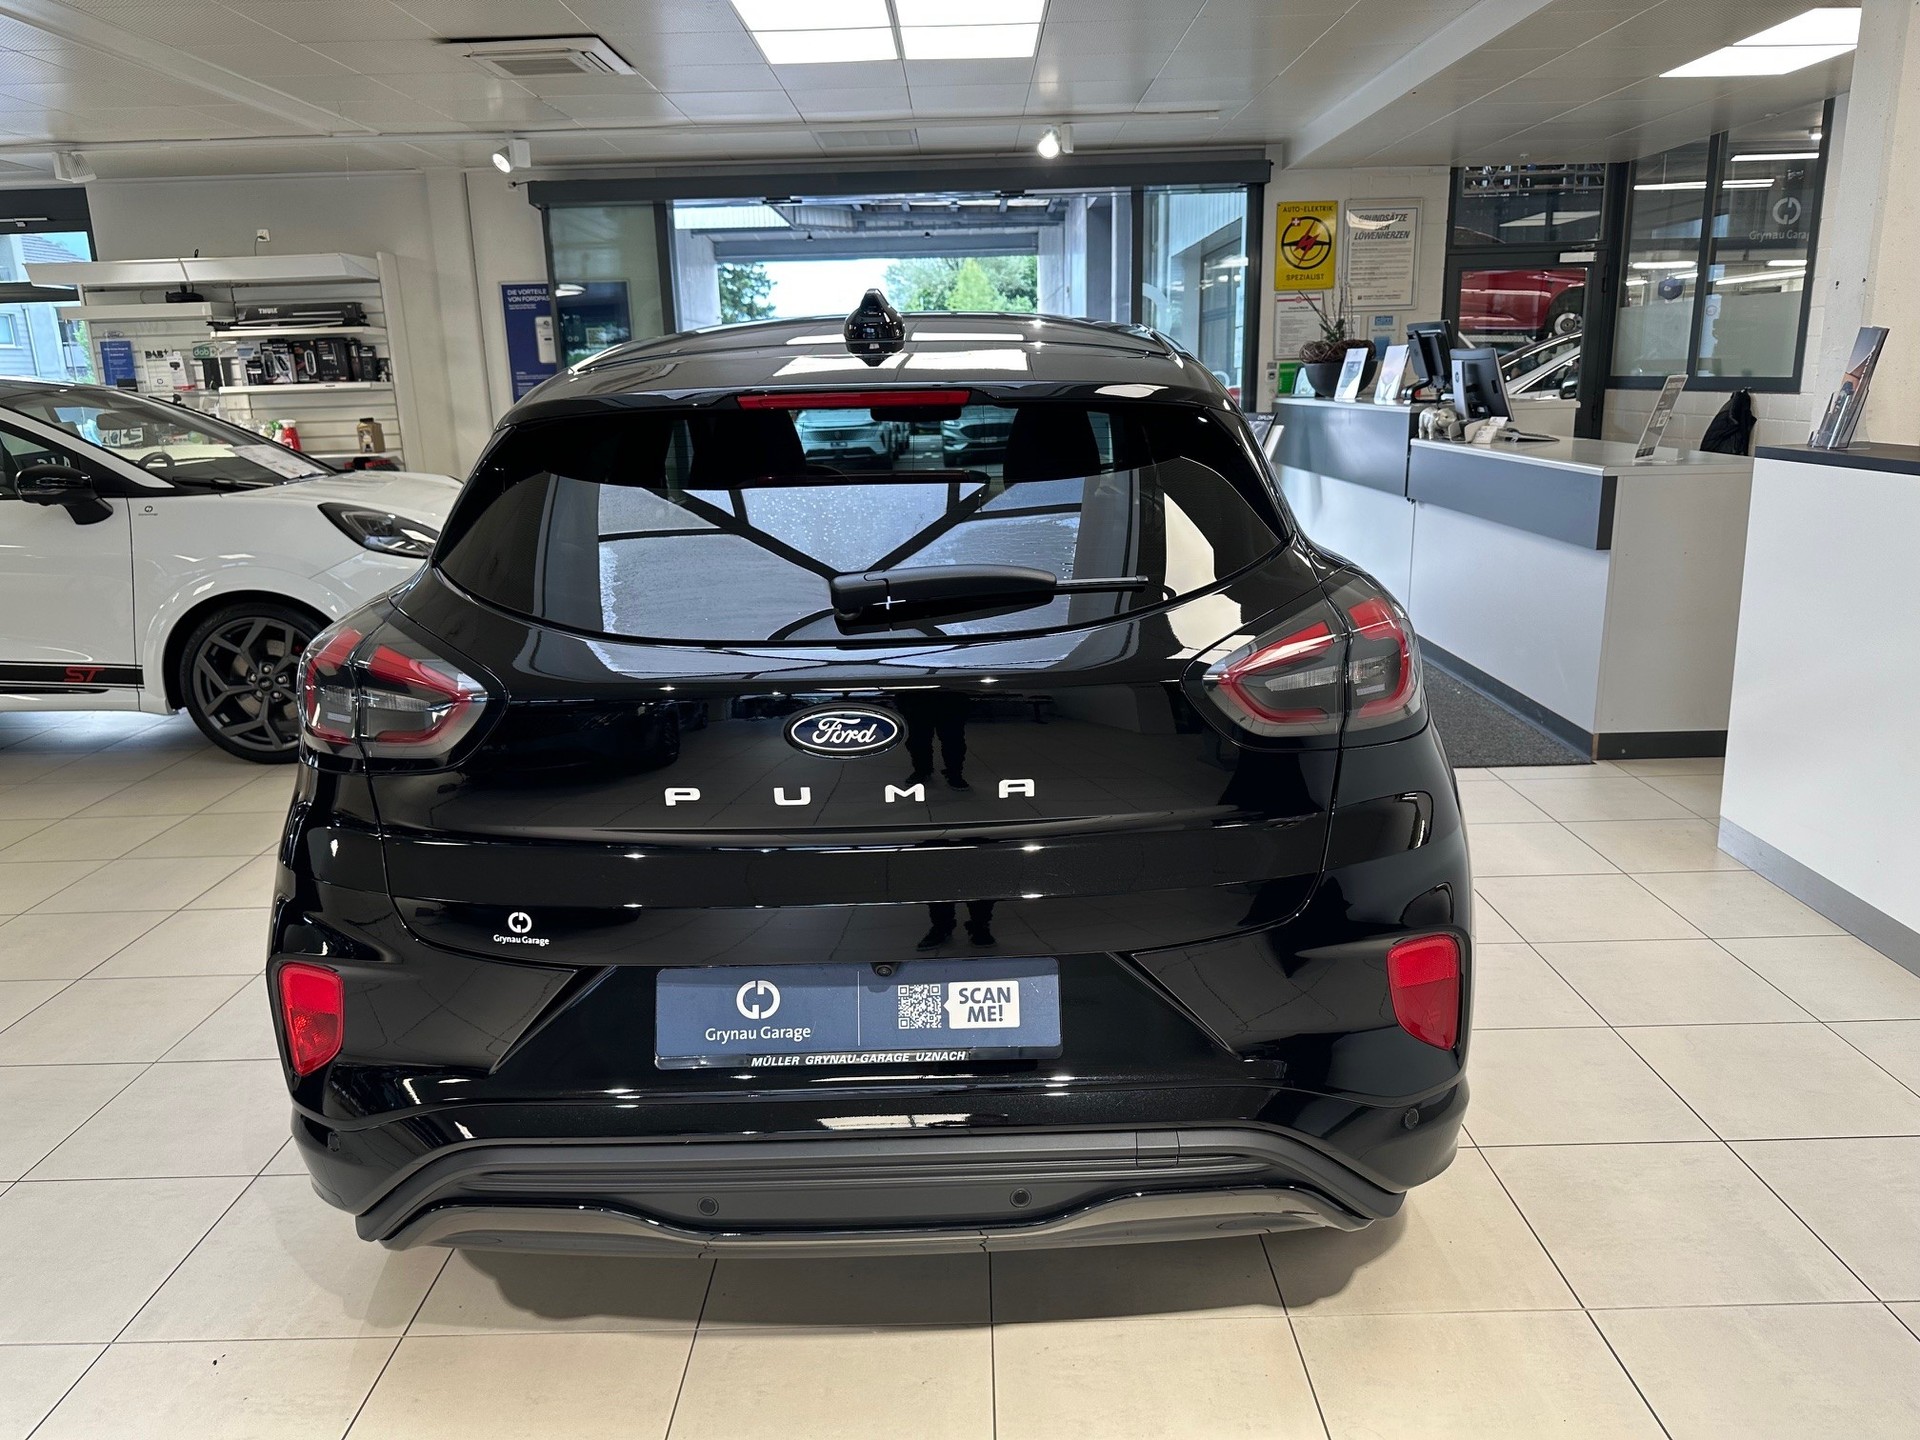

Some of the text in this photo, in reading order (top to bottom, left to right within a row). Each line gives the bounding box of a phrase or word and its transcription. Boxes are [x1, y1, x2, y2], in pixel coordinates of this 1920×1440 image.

[1282, 205, 1334, 213] AUTO-ELEKTRIK
[1354, 230, 1411, 241] LÖWENHERZEN
[1749, 229, 1810, 242] Grynau Gara
[1286, 273, 1325, 282] SPEZIALIST
[507, 287, 547, 296] DIE VORTEILE
[508, 295, 522, 303] VON
[145, 348, 168, 359] DAB+
[64, 666, 106, 683] ST
[811, 717, 878, 745] Ford
[493, 934, 550, 947] Grynau Garage
[958, 986, 1012, 1005] SCAN
[967, 1004, 1004, 1023] ME!
[705, 1025, 812, 1043] Grynau Garage
[751, 1050, 966, 1067] MÜLLER GRYNAU-GARAGE UZNACH
